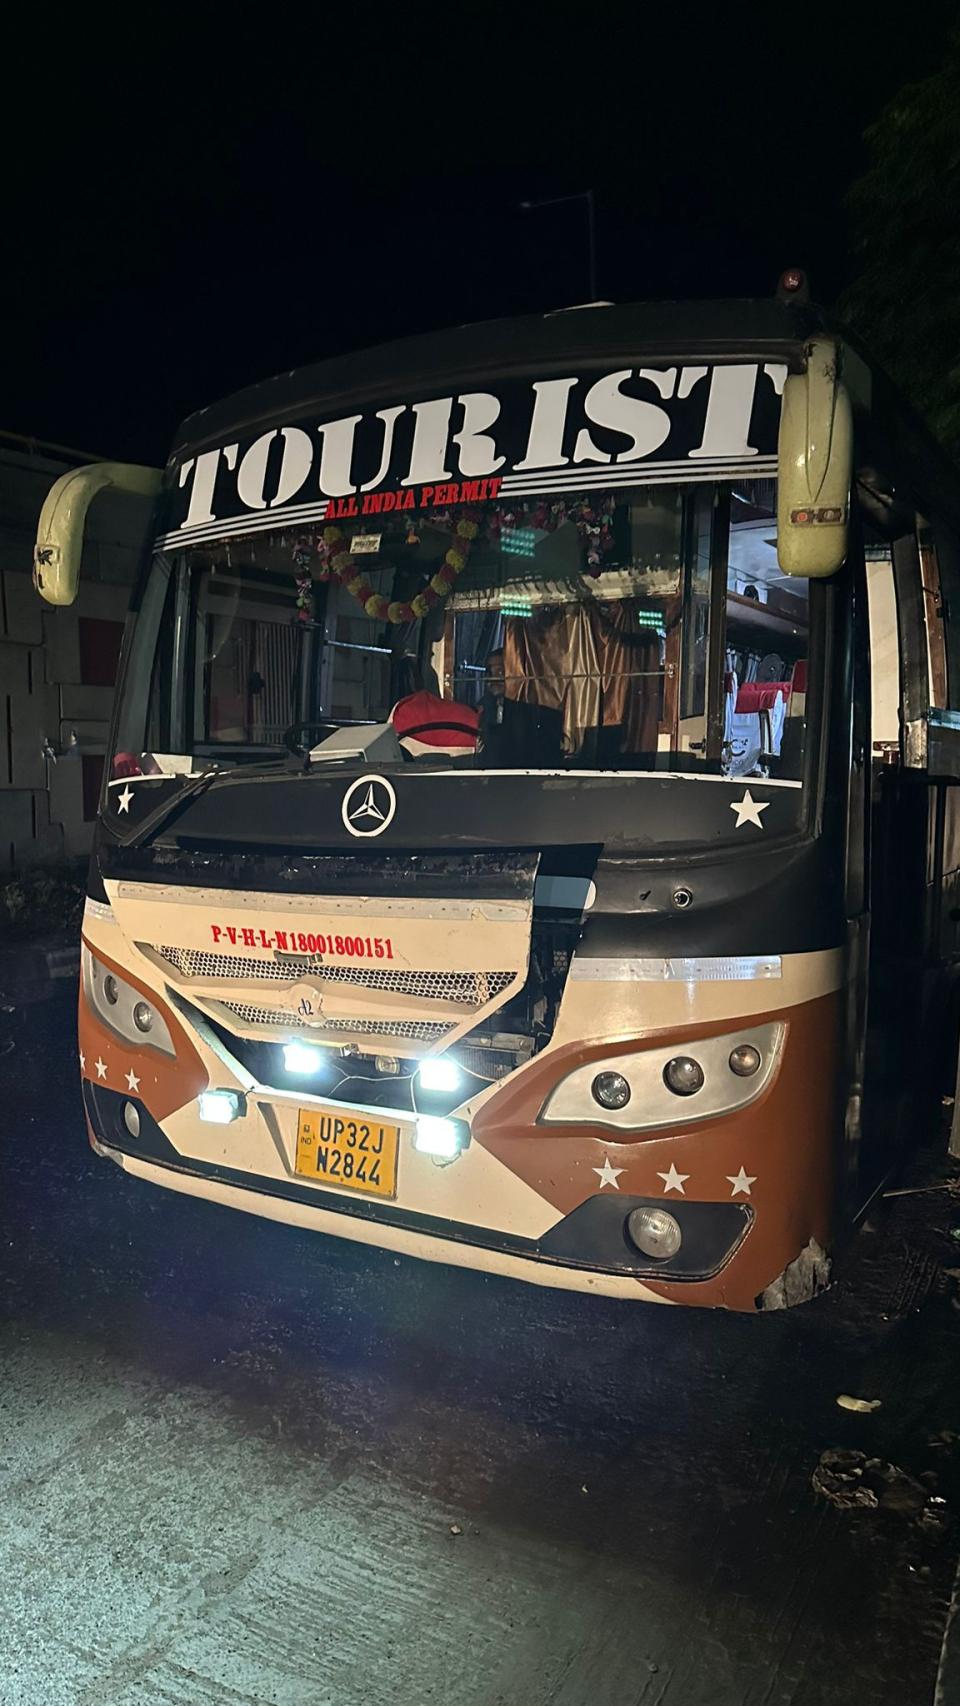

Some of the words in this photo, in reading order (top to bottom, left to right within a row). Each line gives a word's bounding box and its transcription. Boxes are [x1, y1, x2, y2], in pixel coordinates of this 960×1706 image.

[179, 364, 788, 528] TOURIST
[325, 496, 358, 518] ALL
[362, 489, 415, 514] INDIA
[420, 477, 503, 507] PERMIT
[319, 1116, 384, 1154] UP32J
[316, 1146, 380, 1186] N2844
